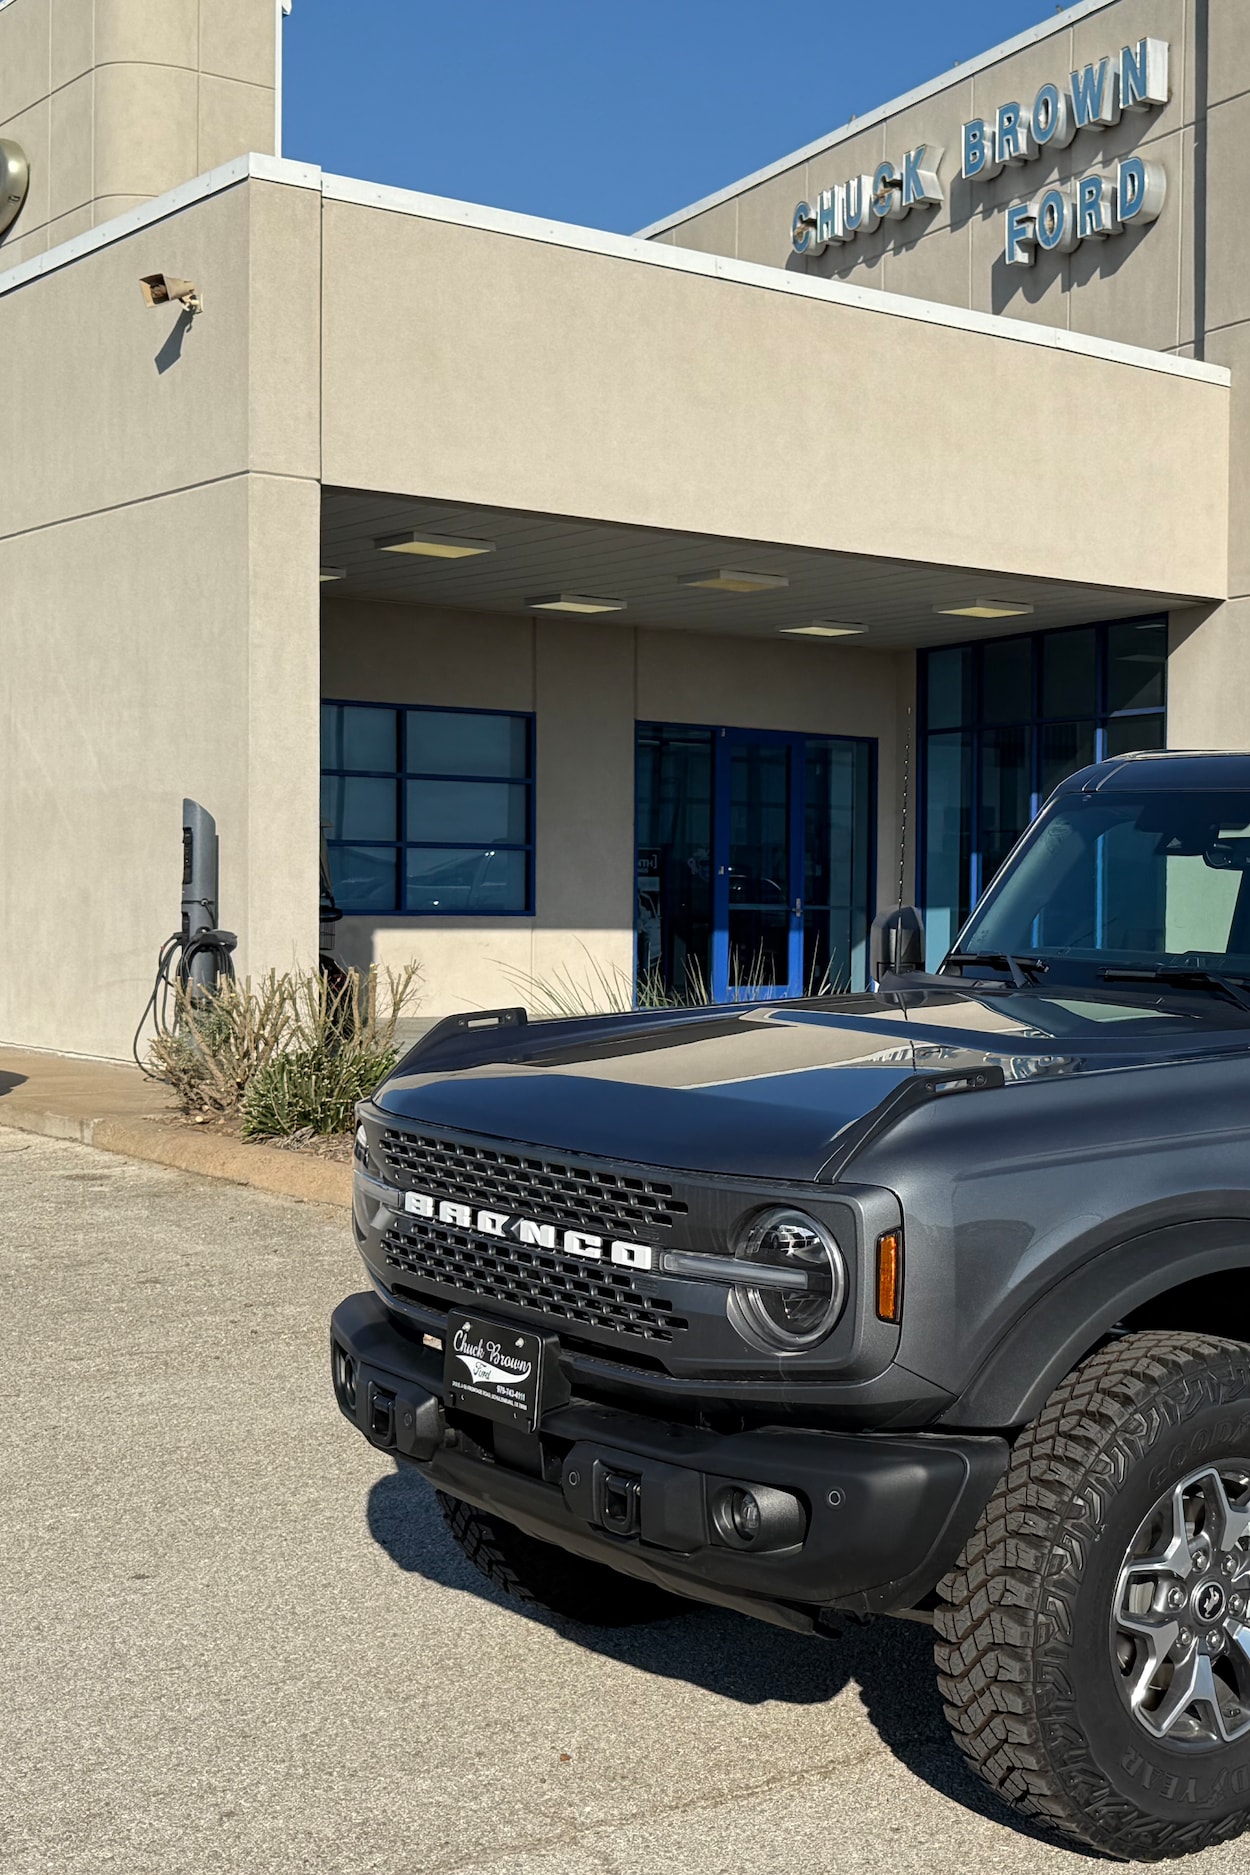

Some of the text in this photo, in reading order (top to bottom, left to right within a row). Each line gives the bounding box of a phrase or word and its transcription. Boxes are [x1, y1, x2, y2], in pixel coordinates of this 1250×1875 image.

[791, 37, 1169, 256] CHUCK BROWN
[1005, 156, 1166, 266] FORD
[405, 1191, 651, 1270] BRONCO
[454, 1330, 531, 1373] Chuck Brown
[473, 1362, 491, 1380] Ford
